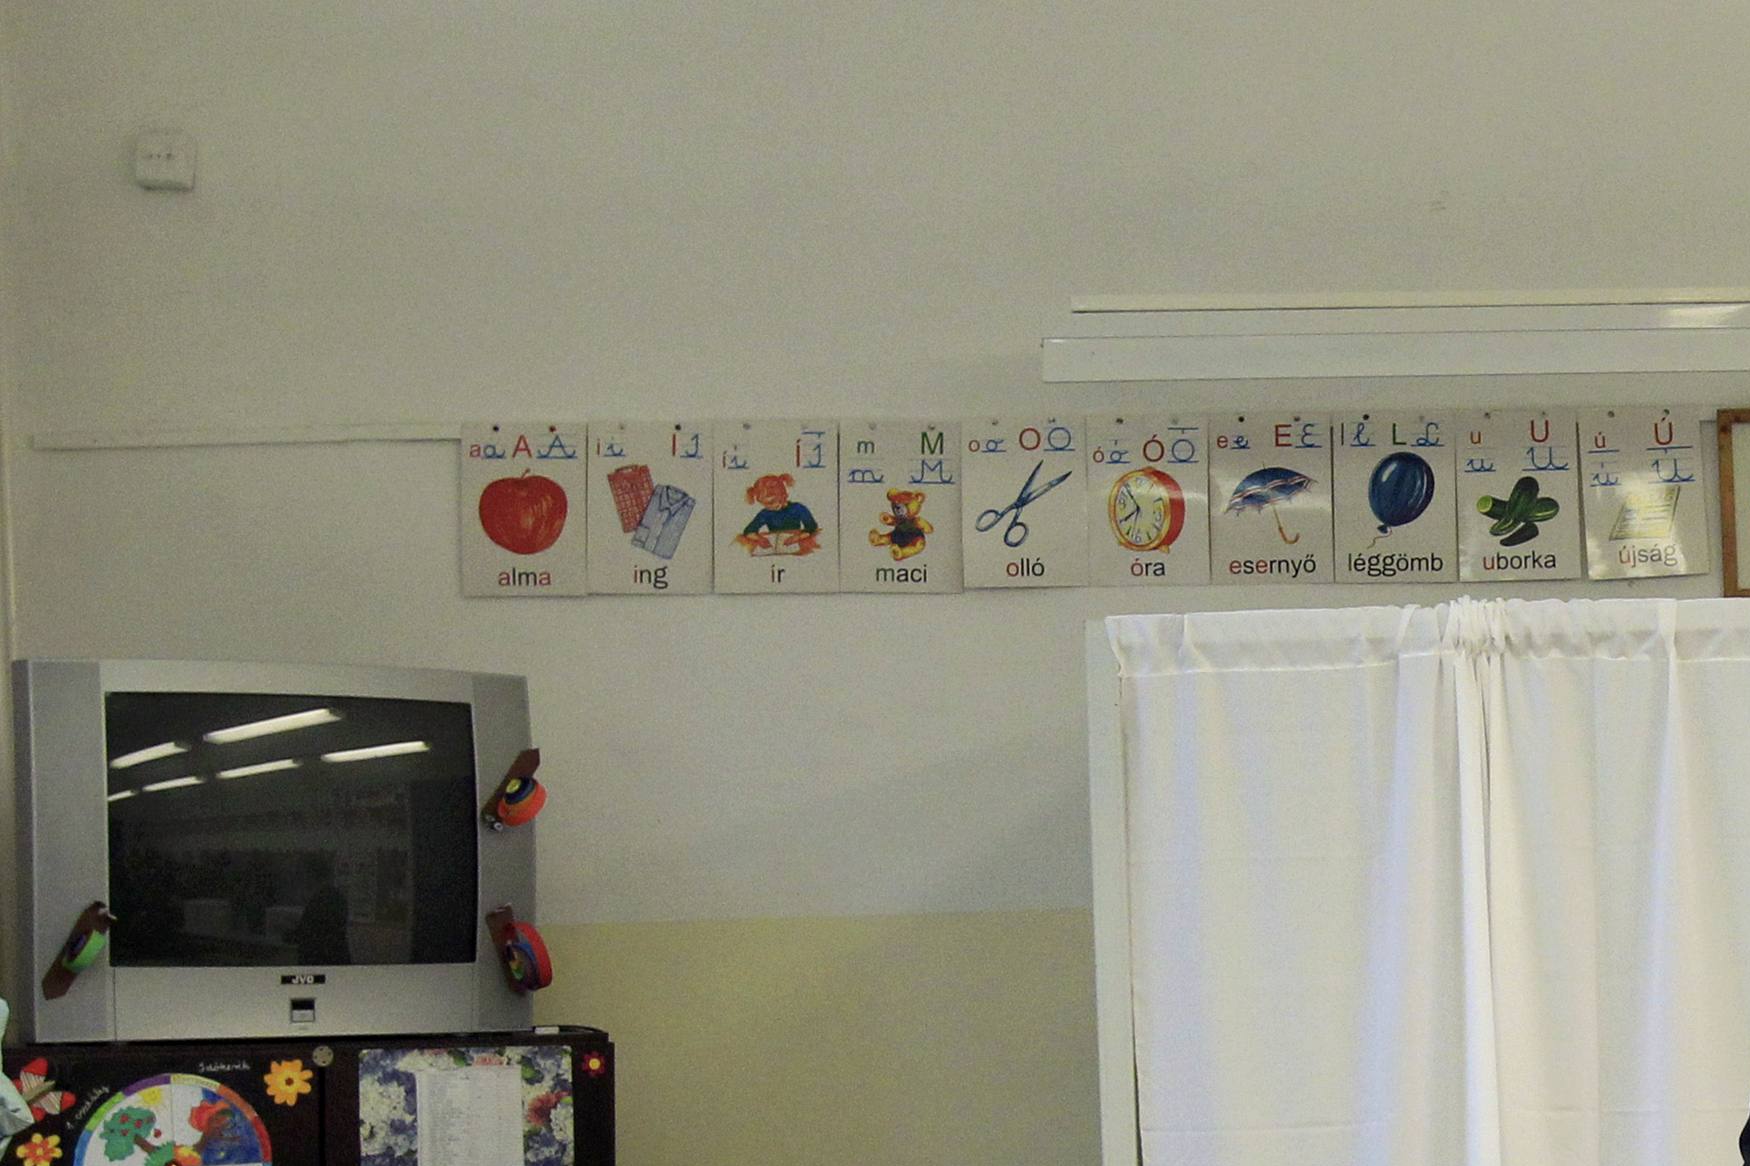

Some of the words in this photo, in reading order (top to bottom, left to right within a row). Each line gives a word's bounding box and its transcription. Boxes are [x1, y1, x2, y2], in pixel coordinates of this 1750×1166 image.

[1348, 553, 1444, 577] léggömb
[1482, 551, 1557, 571] uborka
[1619, 545, 1678, 568] újság
[498, 567, 552, 586] alma
[633, 564, 668, 589] ing
[770, 564, 786, 583] ír
[875, 564, 928, 584] maci
[1006, 557, 1046, 578] olló
[1131, 558, 1166, 578] óra
[1229, 554, 1316, 580] esernyő
[292, 975, 314, 984] JVC
